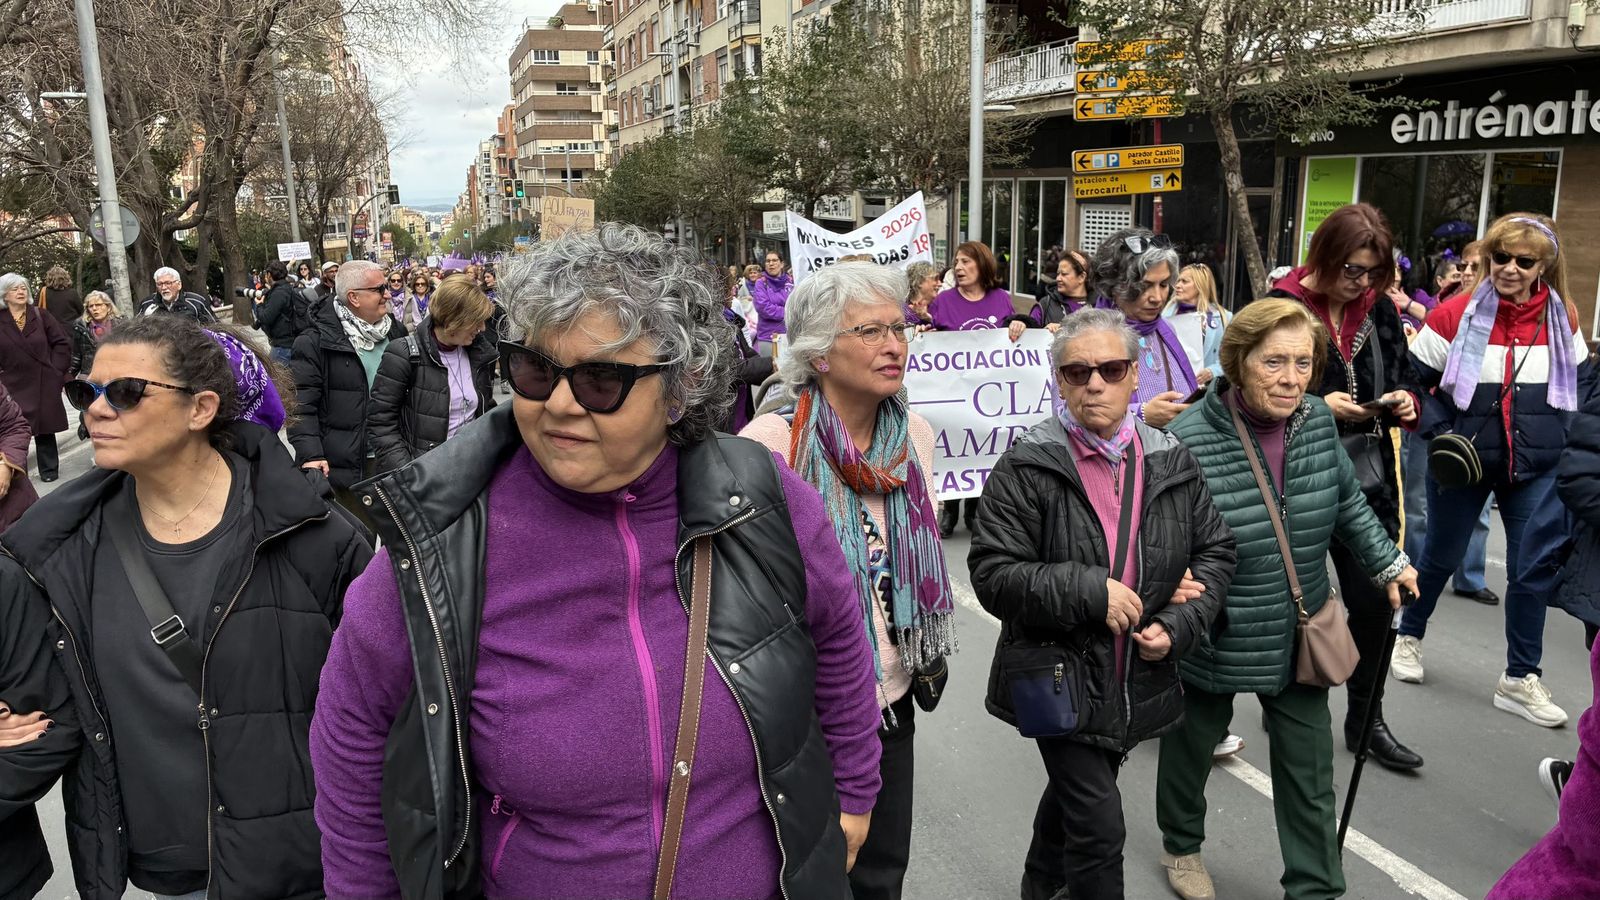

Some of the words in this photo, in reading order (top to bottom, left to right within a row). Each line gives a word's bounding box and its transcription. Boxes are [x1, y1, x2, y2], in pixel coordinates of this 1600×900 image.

[1127, 150, 1153, 159] parador
[1154, 148, 1180, 156] Castillo
[1153, 156, 1180, 164] Catalina
[1075, 184, 1127, 196] ferrocarril
[881, 207, 922, 239] 2026
[913, 233, 929, 255] 18
[906, 344, 1041, 372] ASOCIACIÓN
